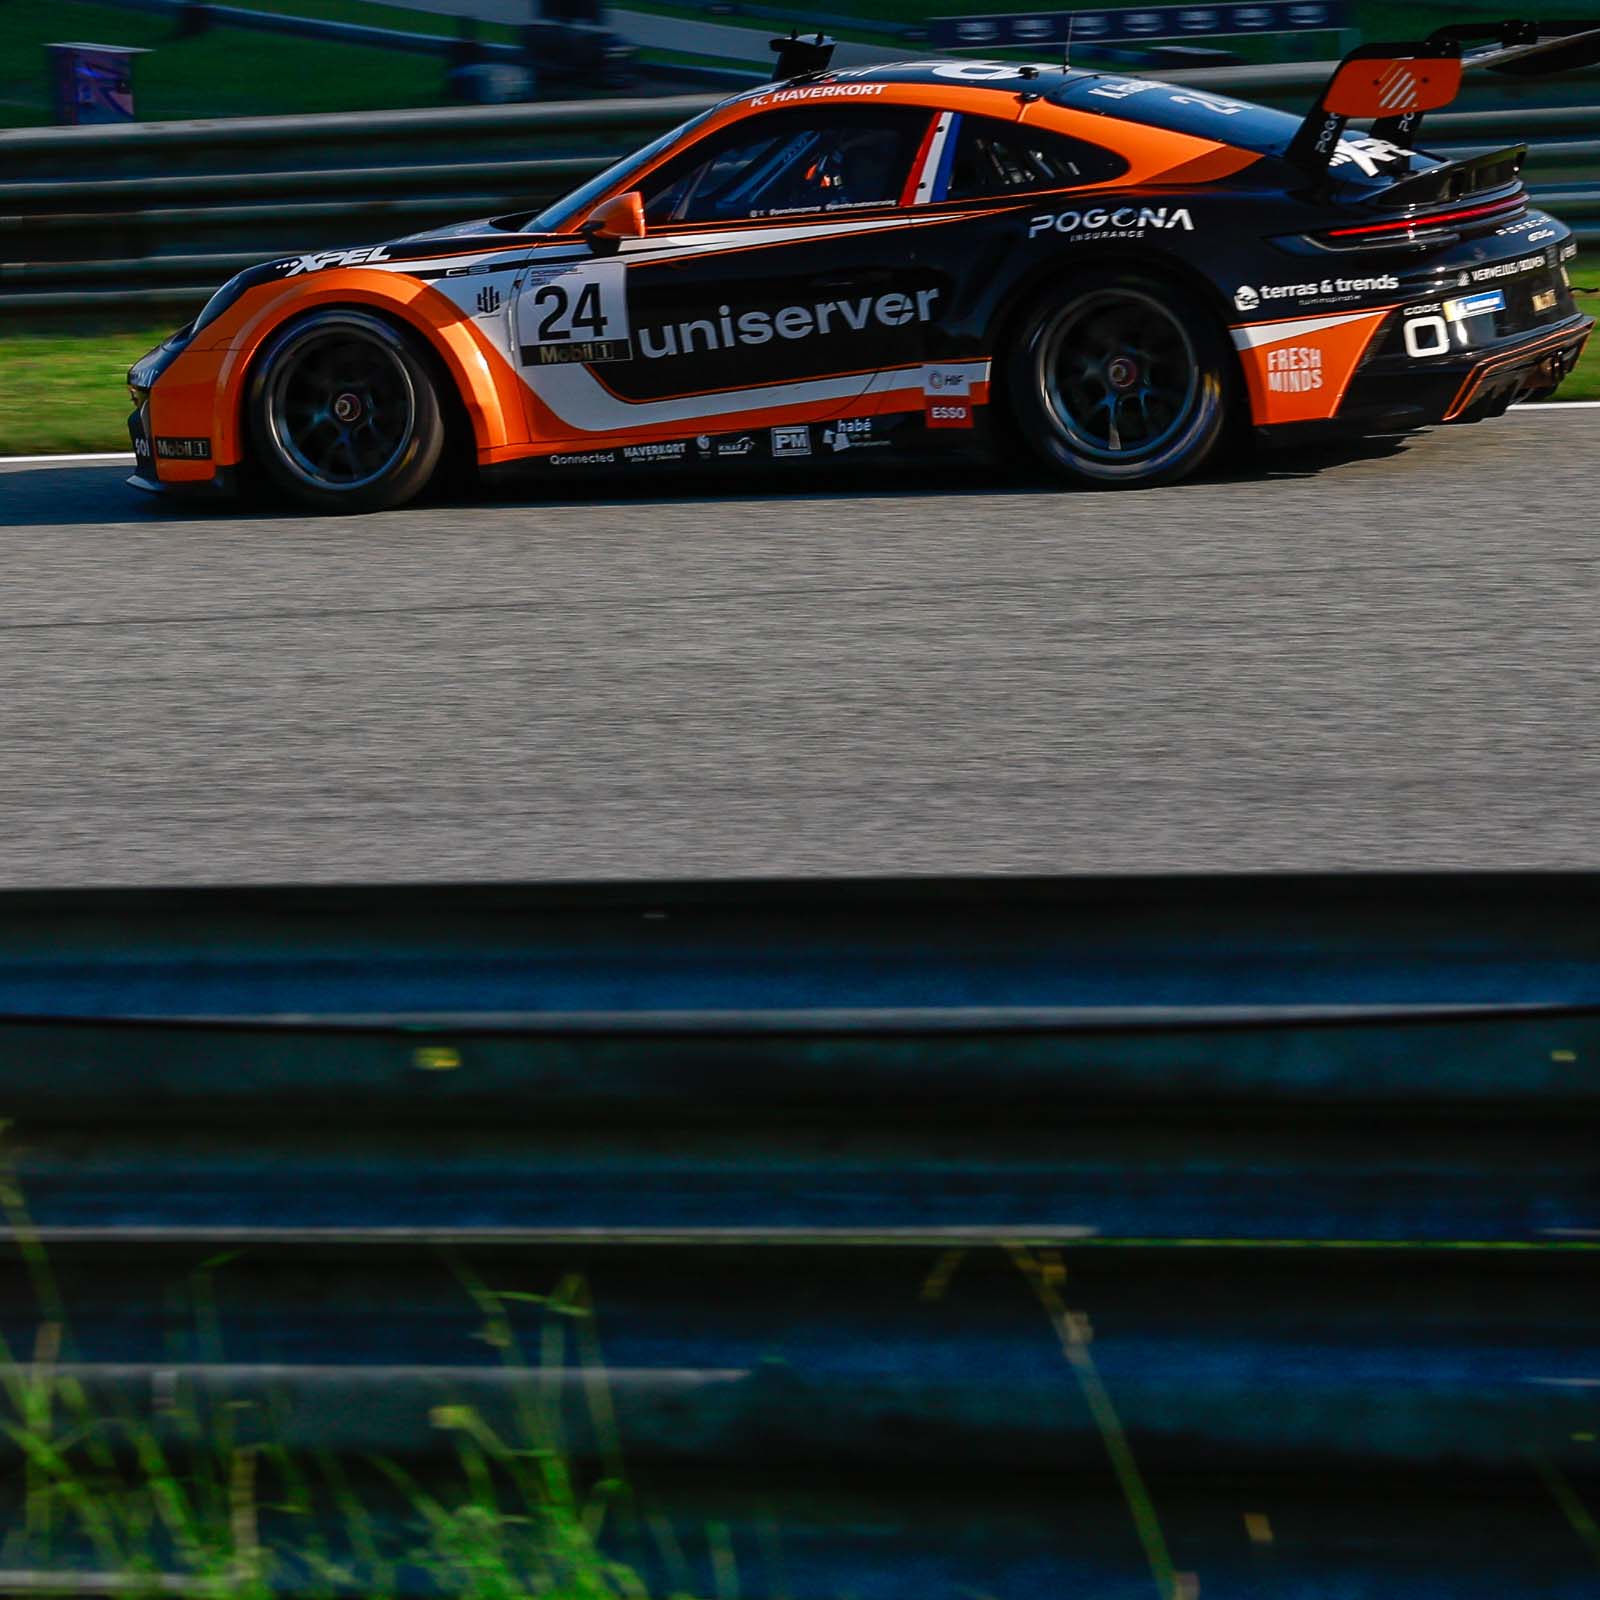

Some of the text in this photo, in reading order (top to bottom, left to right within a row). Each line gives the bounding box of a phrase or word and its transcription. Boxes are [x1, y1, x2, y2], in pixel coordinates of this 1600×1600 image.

[751, 84, 889, 108] K. HAVERKORT
[1028, 206, 1195, 238] POGONA
[1070, 230, 1145, 242] INSURANCE
[285, 246, 391, 277] XPEL
[1260, 274, 1399, 300] terras & trends
[535, 283, 608, 341] 24
[1403, 302, 1441, 316] CODE
[638, 288, 940, 358] uniserver
[540, 344, 592, 364] Mobil
[1267, 347, 1322, 371] FRESH
[1267, 369, 1324, 393] MINDS
[931, 407, 967, 419] ESSO
[837, 418, 871, 433] habé
[157, 440, 192, 457] Mobil
[624, 442, 687, 458] HAVERKORT
[776, 433, 808, 449] PM
[550, 451, 615, 465] Qonnected
